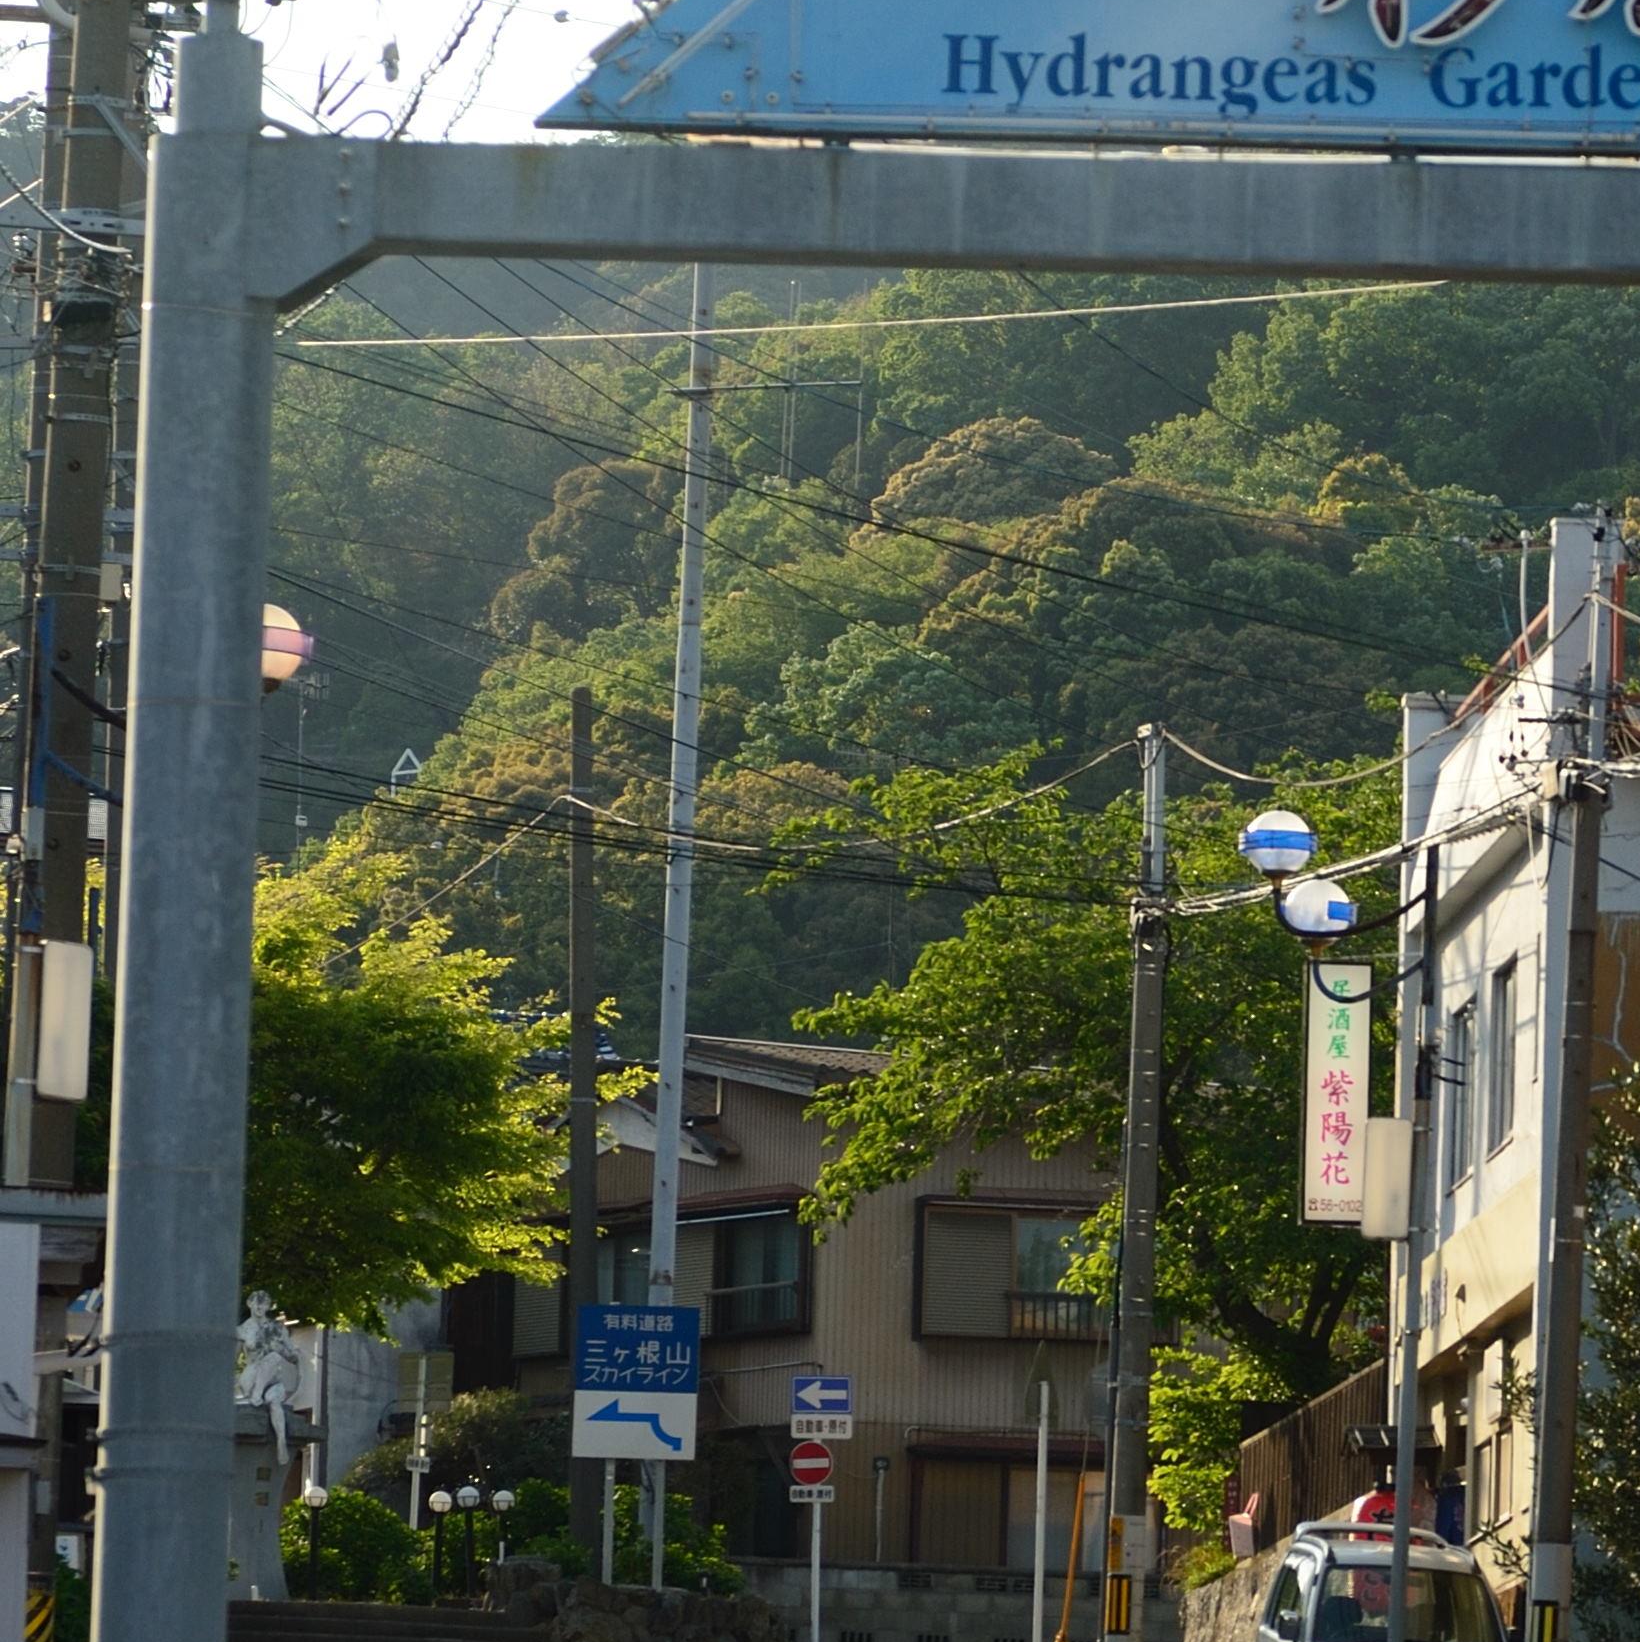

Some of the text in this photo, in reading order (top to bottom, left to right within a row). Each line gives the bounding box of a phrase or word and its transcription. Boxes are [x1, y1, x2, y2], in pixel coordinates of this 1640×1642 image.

[942, 32, 1377, 118] Hydrangeas
[1320, 1069, 1355, 1186] 紫陽花
[603, 1313, 674, 1332] 有料道路
[583, 1364, 690, 1386] スカイライン
